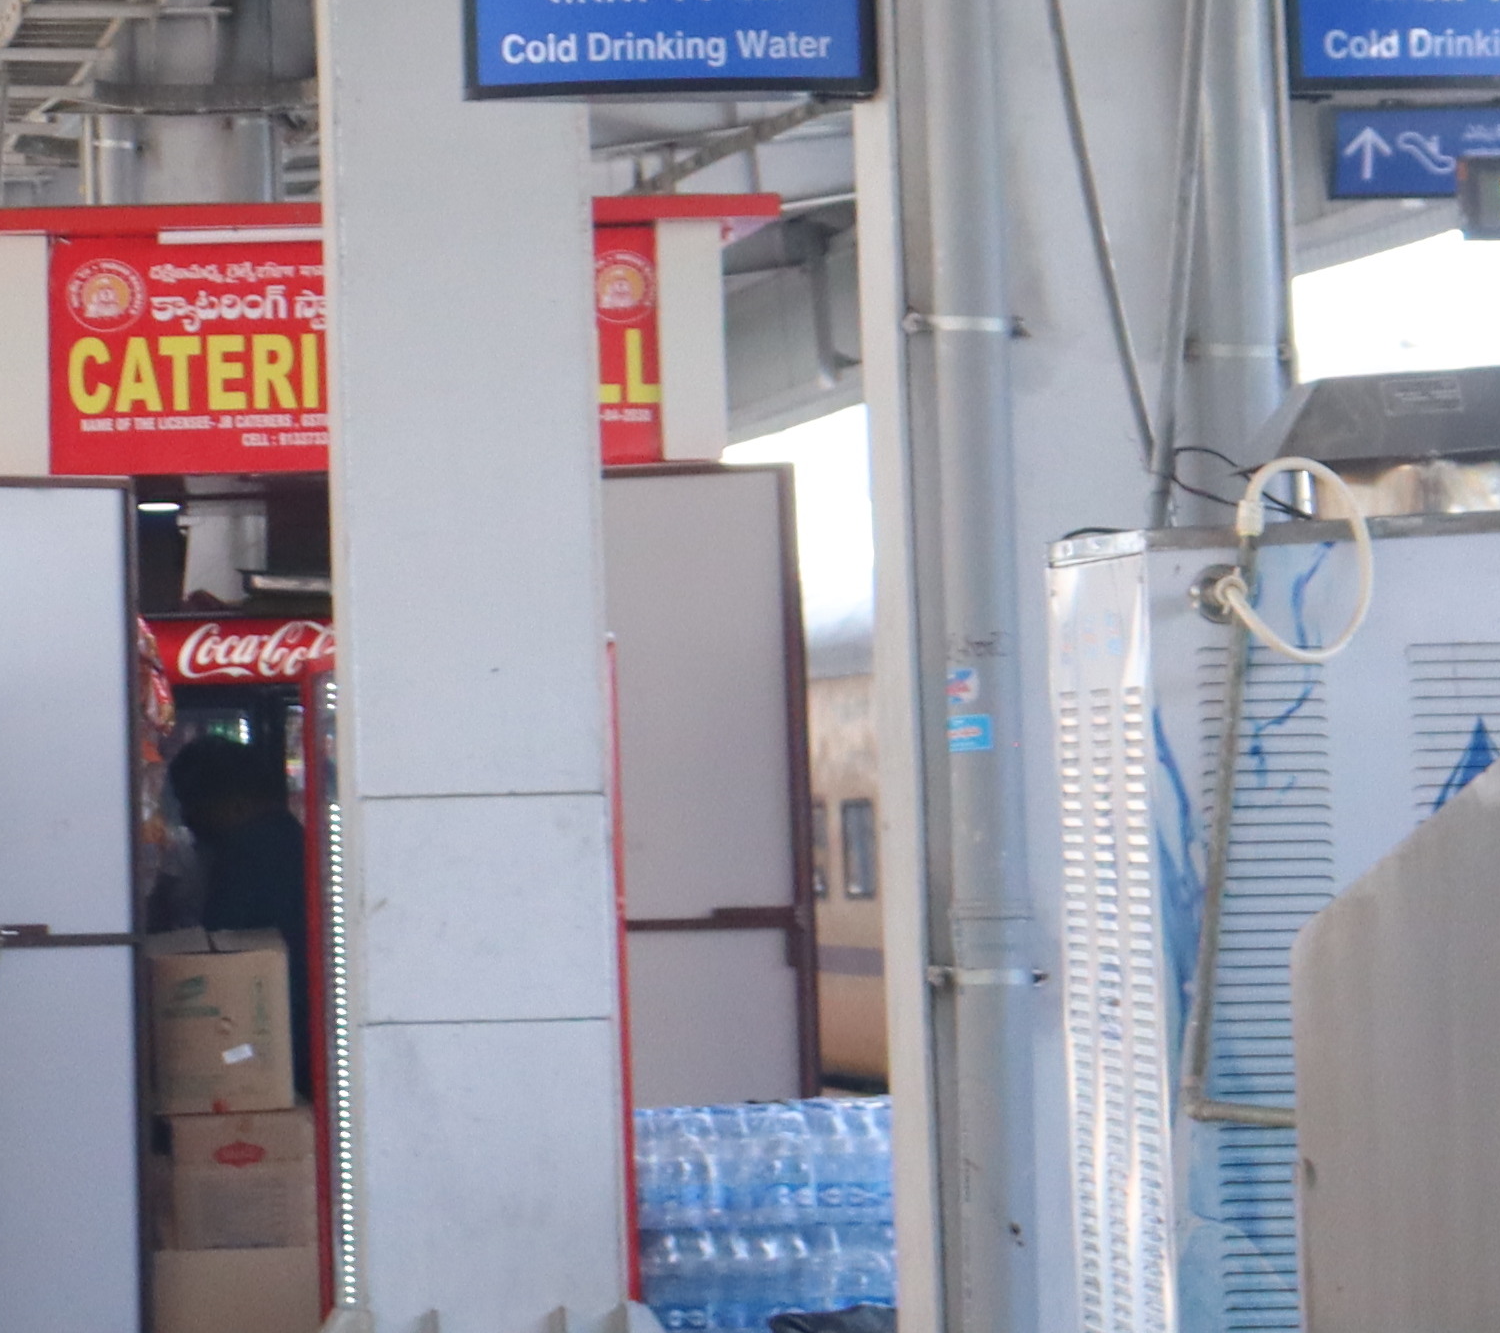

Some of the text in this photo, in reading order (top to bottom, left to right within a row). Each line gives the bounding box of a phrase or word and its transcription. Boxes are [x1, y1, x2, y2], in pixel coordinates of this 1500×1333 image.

[502, 30, 830, 67] Cold Drinking Water
[1326, 31, 1399, 58] Cold
[68, 333, 319, 414] CATERI
